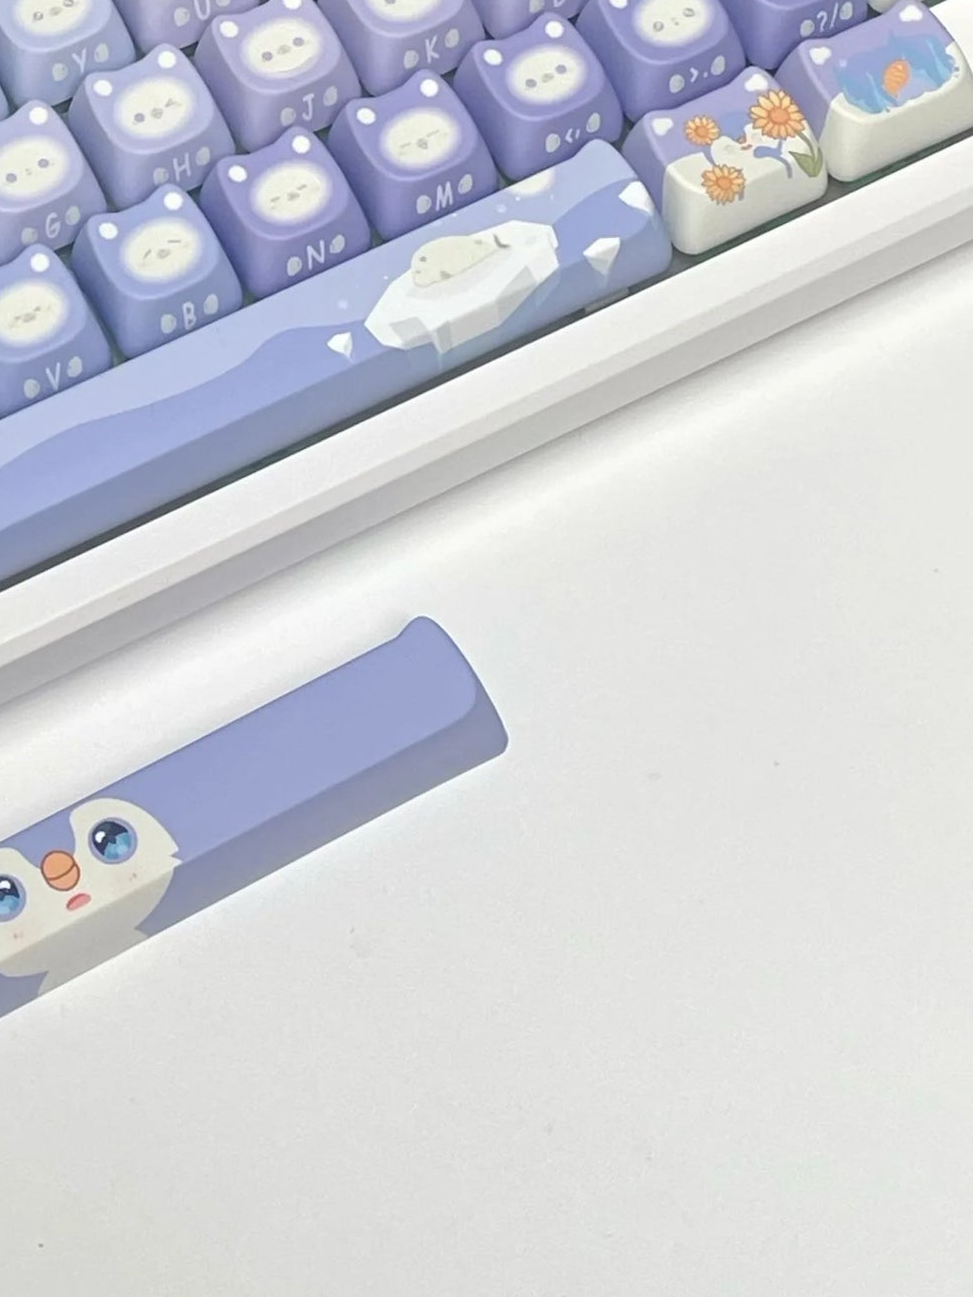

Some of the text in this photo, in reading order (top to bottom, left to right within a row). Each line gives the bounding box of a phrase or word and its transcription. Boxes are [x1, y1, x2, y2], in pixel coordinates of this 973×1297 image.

[72, 48, 87, 72] Y
[425, 36, 440, 63] K
[302, 93, 315, 121] J
[173, 153, 191, 181] H
[435, 182, 453, 211] M
[45, 213, 61, 238] G
[306, 240, 325, 270] N
[182, 302, 197, 330] B
[45, 362, 61, 392] V
